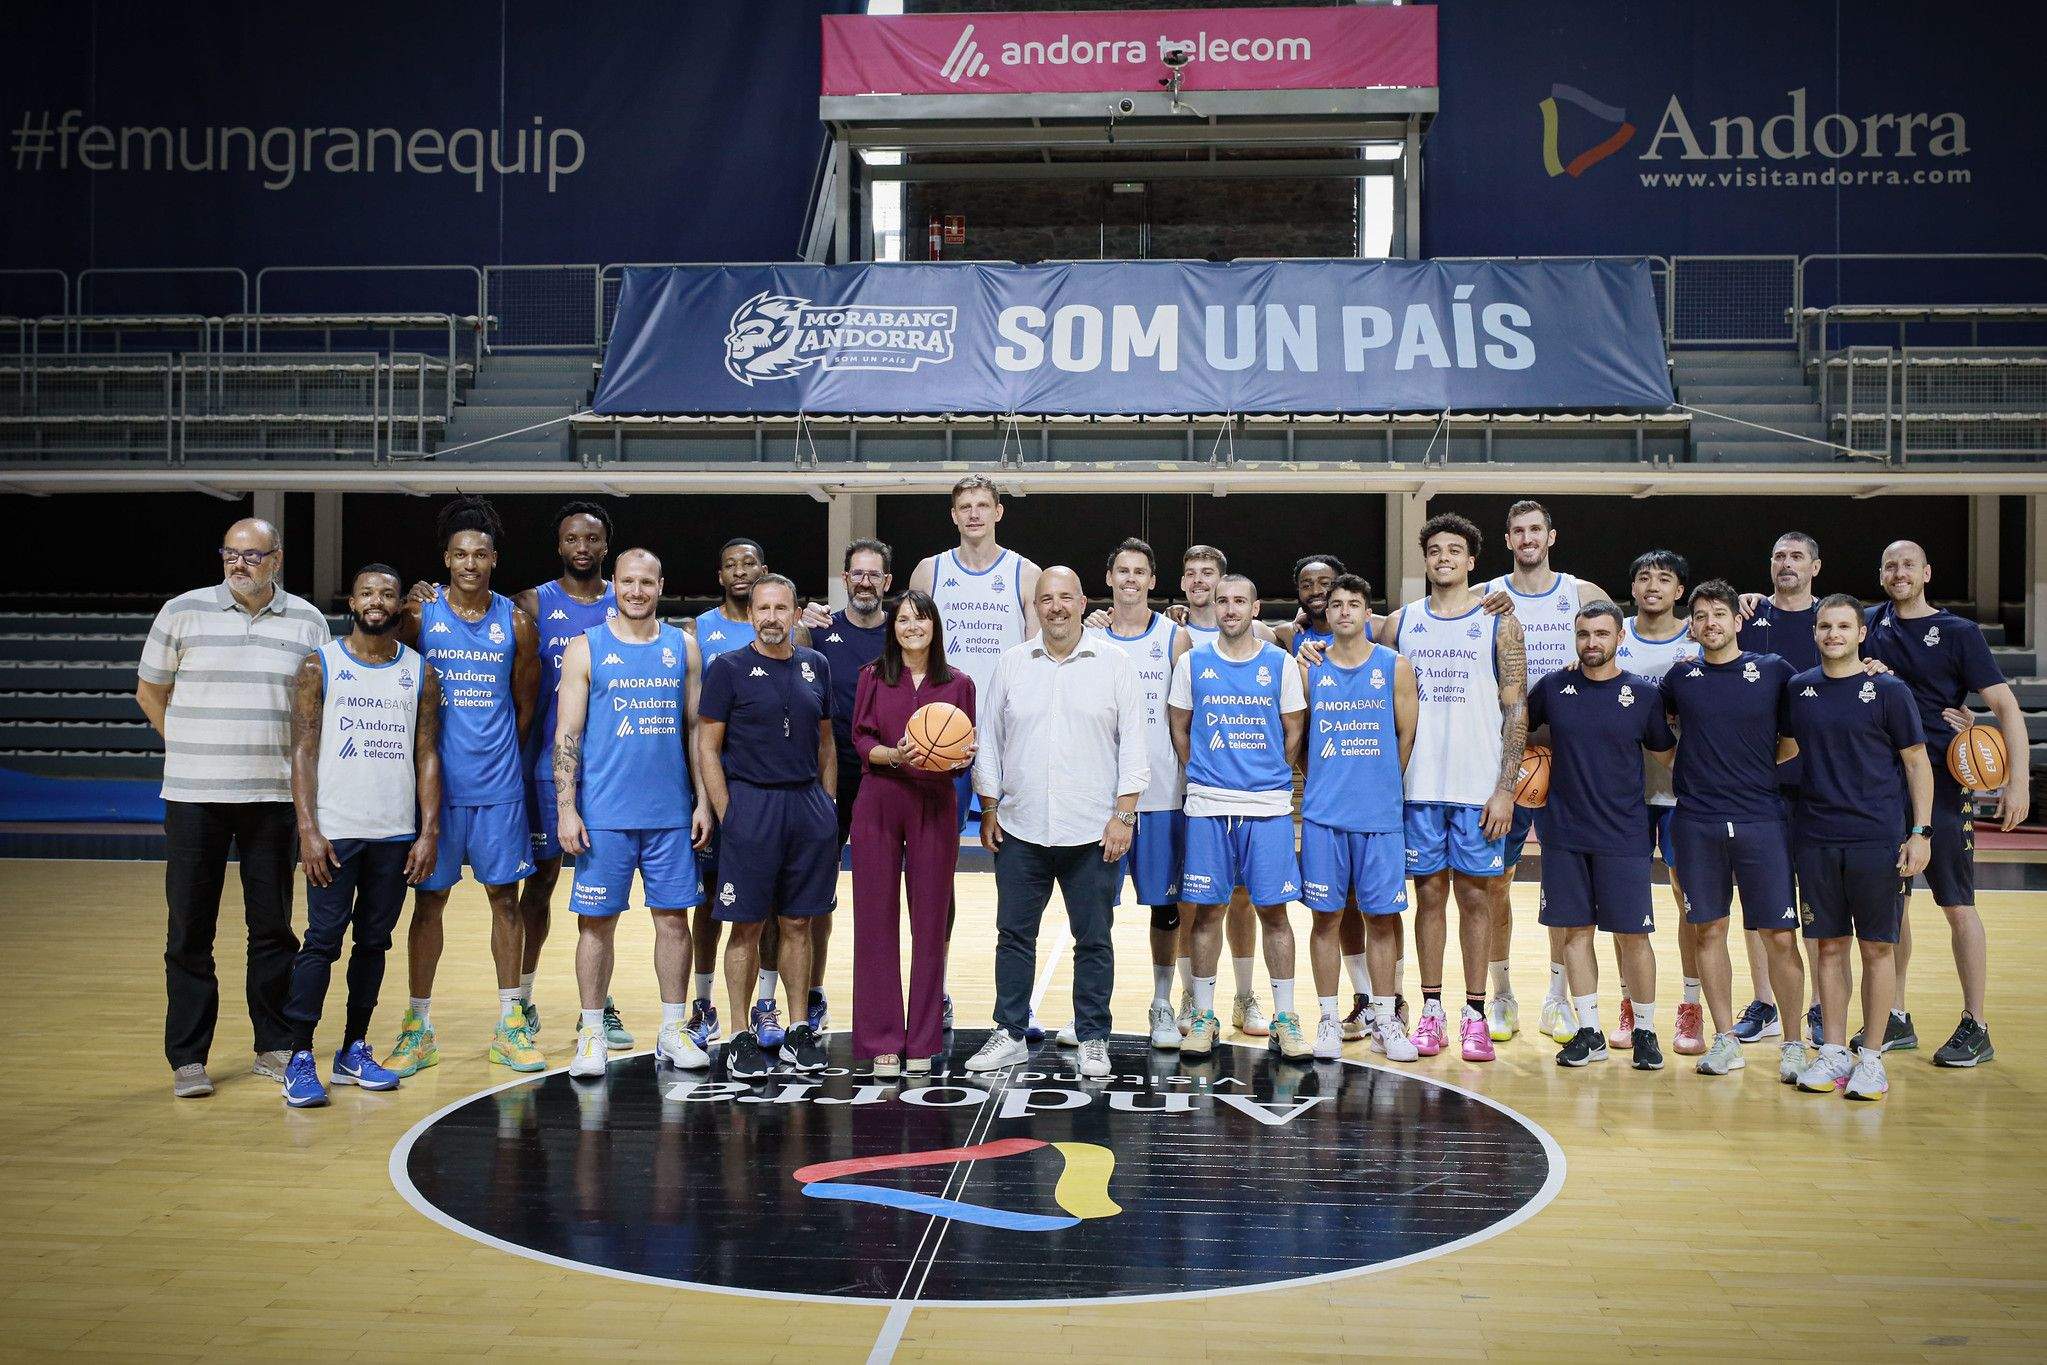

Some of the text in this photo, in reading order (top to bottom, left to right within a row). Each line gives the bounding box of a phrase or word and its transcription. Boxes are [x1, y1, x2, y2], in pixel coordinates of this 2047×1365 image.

[1001, 31, 1311, 65] andorra telecom
[1639, 87, 1971, 160] Andorra
[11, 110, 586, 192] #femungranequip
[1639, 166, 1971, 188] www.visitandorra.com
[803, 311, 948, 327] MORABANC
[995, 284, 1536, 372] SOM UN PAÍS
[800, 328, 945, 354] ANDORRA
[834, 356, 858, 364] SOM
[882, 356, 906, 364] PAÍS
[952, 602, 1010, 613] MORABANC
[958, 620, 1003, 631] Andorra
[1522, 622, 1571, 632] ORABANC
[965, 636, 1000, 645] andorra
[1524, 641, 1566, 651] ndorra
[438, 649, 504, 663] MORABANC
[965, 646, 1001, 655] telecom
[1417, 649, 1477, 660] MORABANC
[1527, 657, 1563, 665] andorra
[445, 669, 496, 683] Andorra
[1425, 667, 1469, 679] Andorra
[620, 678, 680, 688] MORABANC
[1432, 684, 1465, 693] andorra
[453, 687, 492, 698] andorra
[347, 696, 413, 712] MORABANC
[453, 697, 494, 708] telecom
[629, 698, 677, 709] Andorra
[1212, 695, 1272, 707] MORABANC
[1433, 694, 1466, 703] telecom
[1325, 699, 1386, 711] MORABANC
[638, 716, 675, 724] andorra
[1220, 713, 1267, 725] Andorra
[355, 718, 406, 733] Andorra
[639, 725, 676, 734] telecom
[1334, 719, 1379, 731] Andorra
[1228, 731, 1265, 740] andorra
[1340, 736, 1378, 746] andorra
[363, 739, 403, 750] andorra
[1228, 740, 1267, 750] telecom
[363, 749, 405, 760] telecom
[1341, 746, 1380, 756] telecom
[664, 1081, 1335, 1125] Andorra
